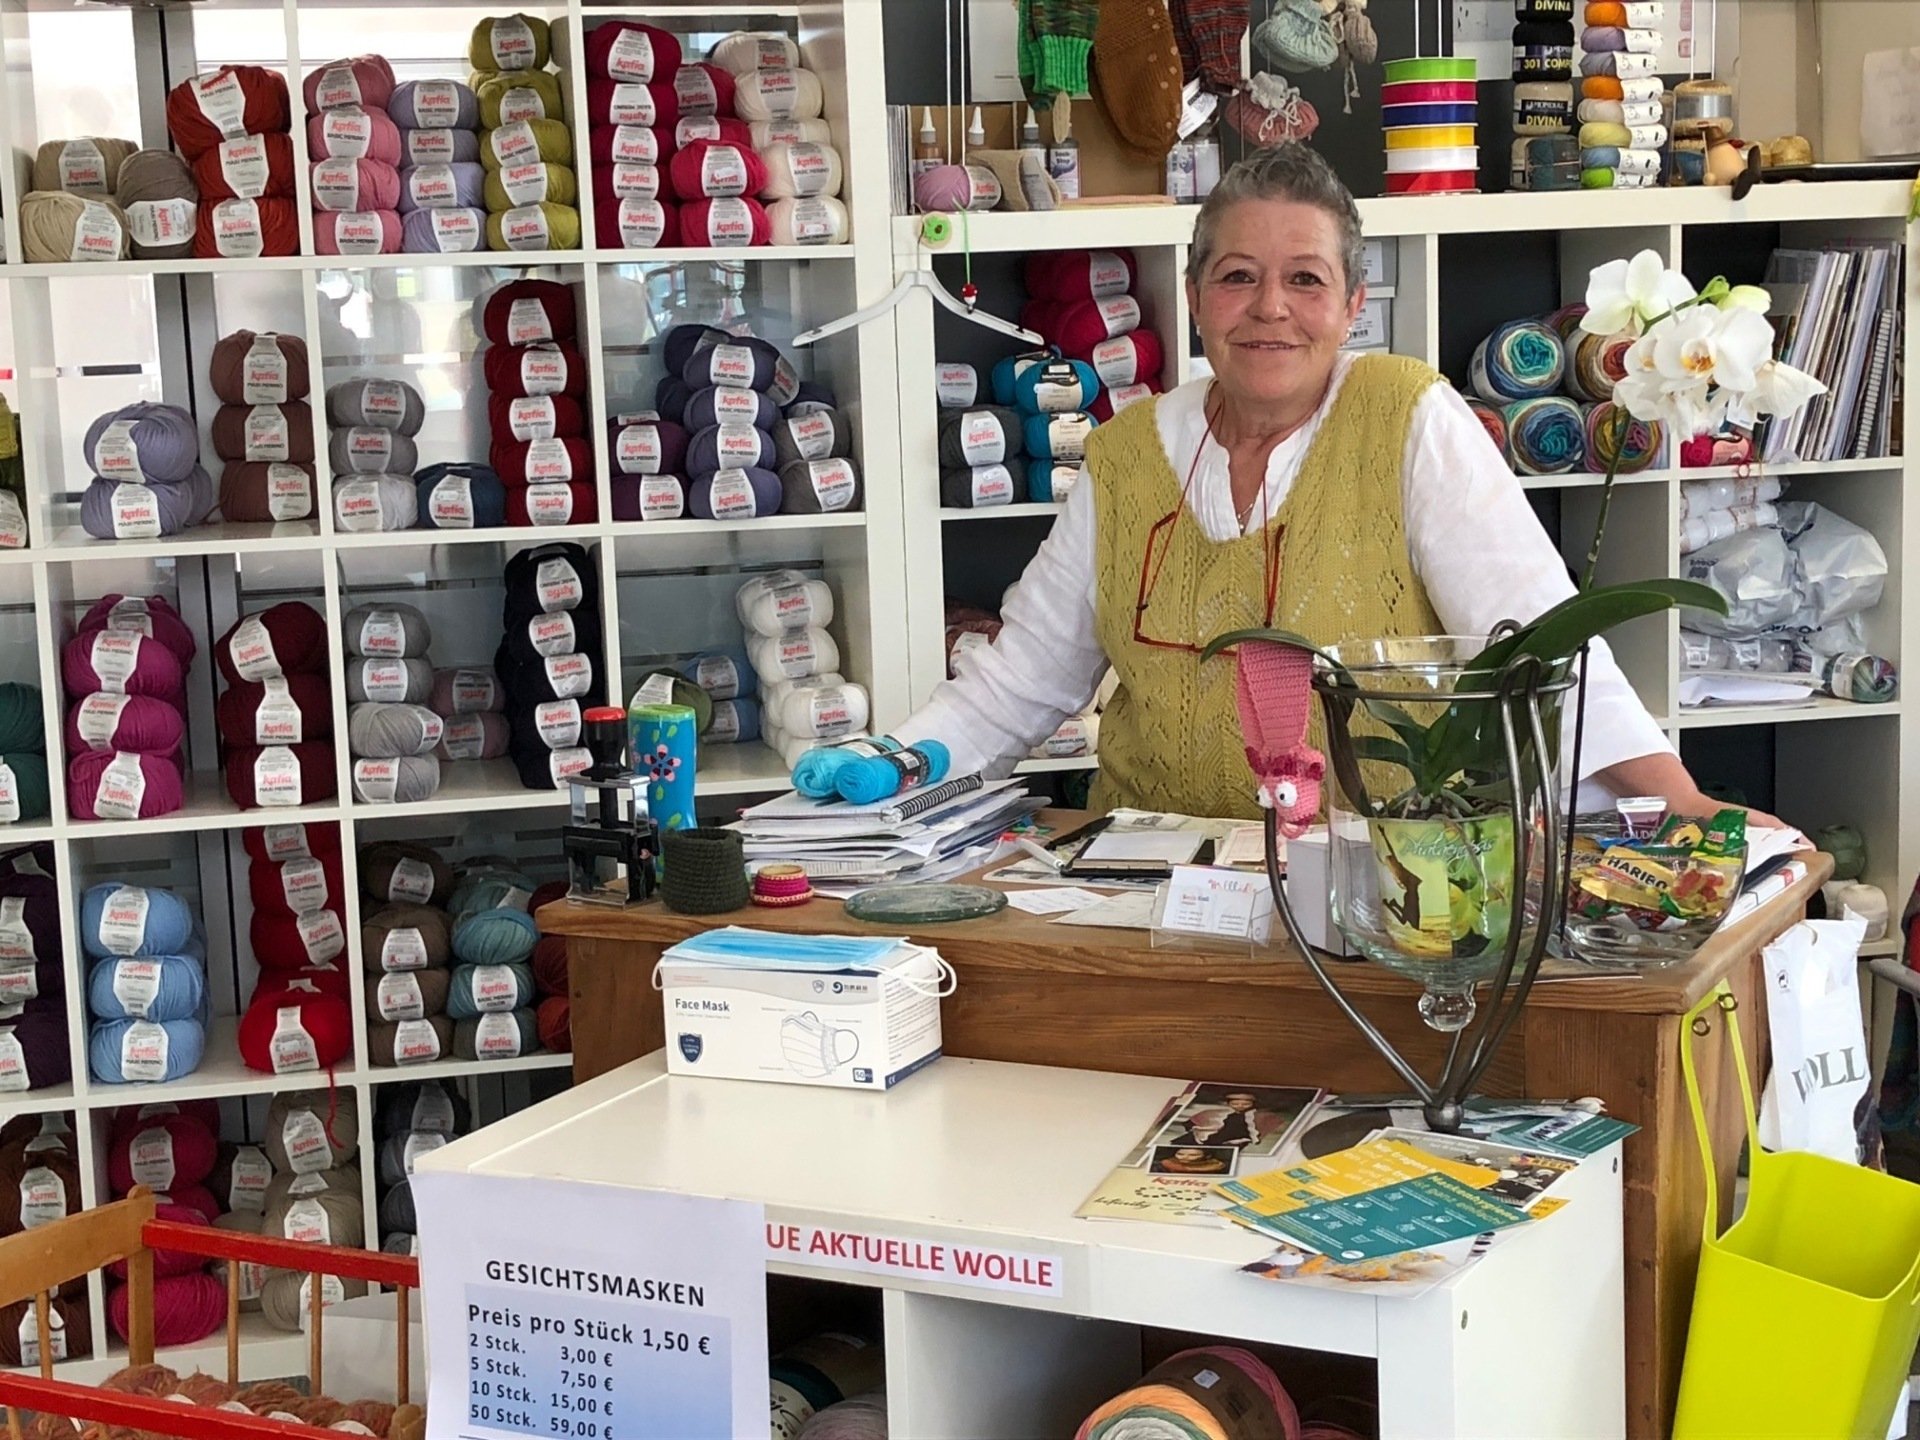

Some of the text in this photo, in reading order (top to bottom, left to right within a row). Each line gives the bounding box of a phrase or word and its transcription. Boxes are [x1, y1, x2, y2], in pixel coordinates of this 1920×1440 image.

[1535, 0, 1571, 11] DIVINA
[1524, 58, 1540, 69] 301
[1526, 115, 1564, 127] DIVINA
[1607, 856, 1668, 890] HARIBO
[675, 998, 730, 1012] Face Mask
[766, 1223, 1053, 1288] UE AKTUELLE WOLLE
[486, 1260, 704, 1306] GESICHTSMASKEN
[469, 1304, 710, 1355] Preis pro Stück 1,50 €
[470, 1334, 613, 1367] 2 Stck. 3,00 €
[471, 1357, 614, 1392] 5 Stck. 7,50 €
[472, 1381, 614, 1416] 10 Stck. 15,00 €
[471, 1405, 614, 1440] 50 Stck. 59,00 €
